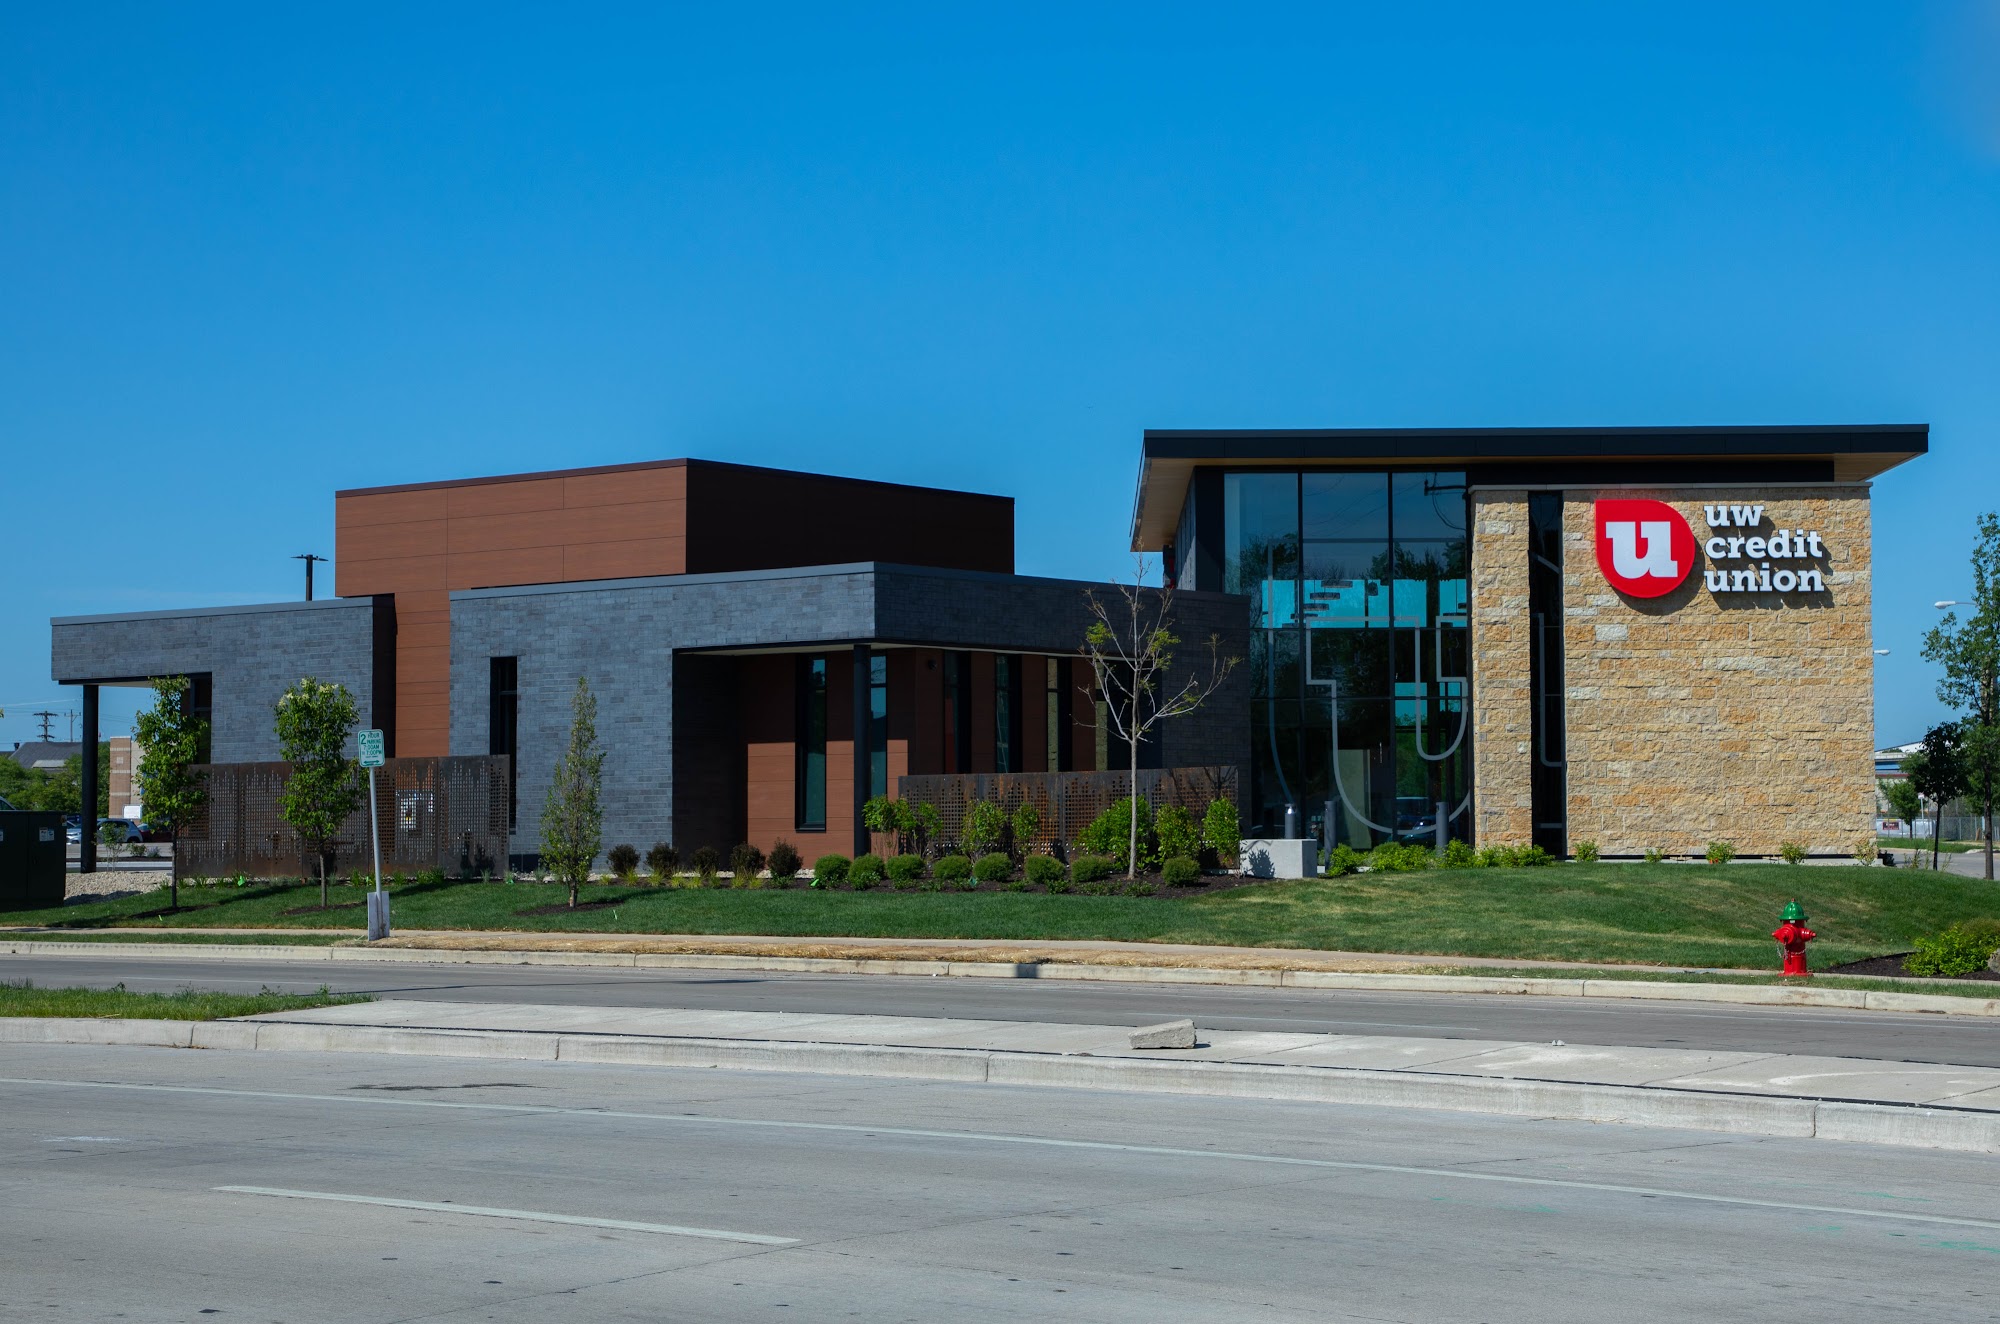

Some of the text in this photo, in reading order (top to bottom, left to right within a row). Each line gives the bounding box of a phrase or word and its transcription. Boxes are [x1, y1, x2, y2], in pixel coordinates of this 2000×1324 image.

[1703, 504, 1764, 527] uw
[1605, 521, 1678, 579] u
[1705, 529, 1822, 559] credit
[1704, 562, 1824, 592] union
[360, 733, 366, 745] 2
